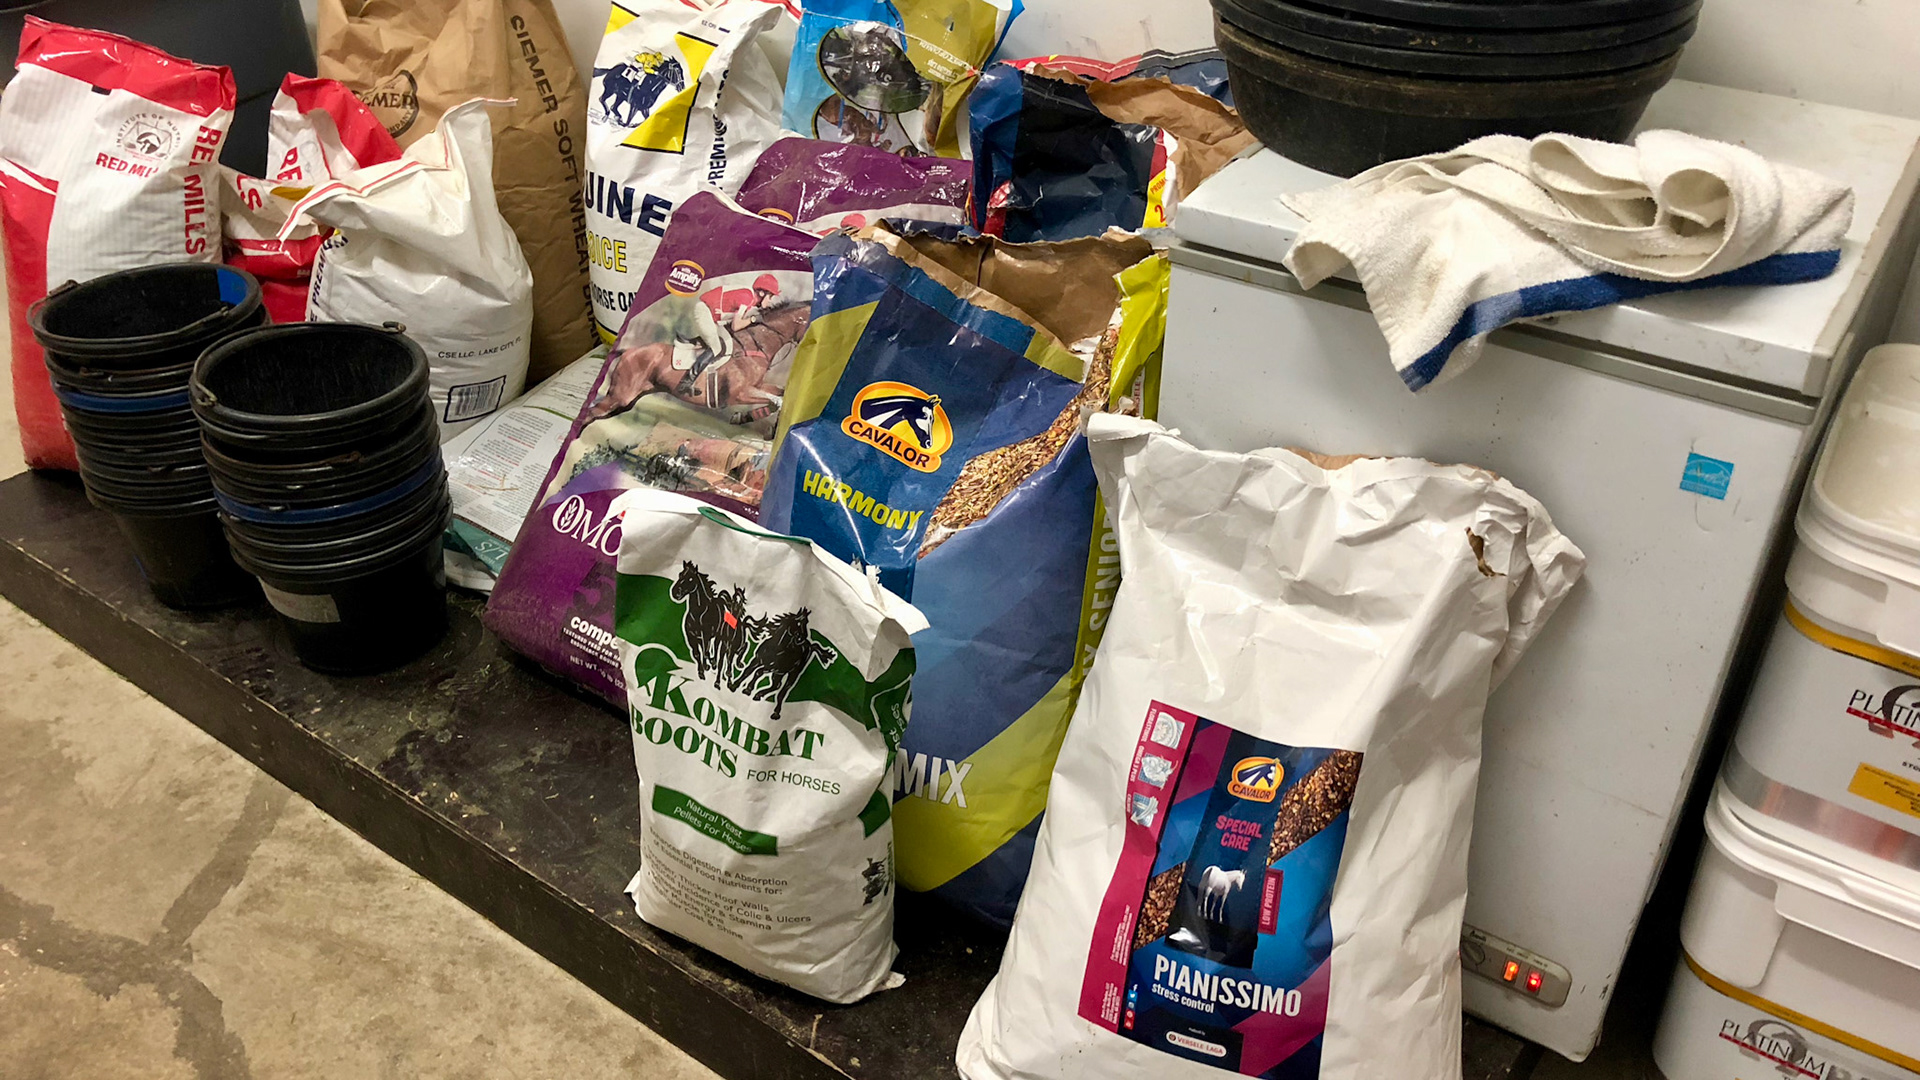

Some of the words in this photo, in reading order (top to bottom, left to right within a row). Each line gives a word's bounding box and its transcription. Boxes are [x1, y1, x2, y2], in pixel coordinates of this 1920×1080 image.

[117, 113, 147, 147] INSTITUTE
[95, 152, 128, 172] RED
[554, 119, 579, 183] SOFT
[184, 174, 206, 255] MILLS
[585, 169, 673, 238] UINE
[670, 267, 702, 287] Amplify
[438, 350, 457, 359] CSE
[478, 346, 499, 356] LAKE
[500, 339, 515, 352] CITY
[849, 421, 931, 468] CAVALOR
[802, 469, 925, 531] HARMONY
[570, 655, 584, 667] NET
[646, 671, 825, 761] KOMBAT
[631, 703, 739, 779] BOOTS
[747, 769, 777, 783] FOR
[781, 770, 842, 796] HORSES
[893, 748, 974, 809] MIX
[1232, 783, 1272, 800] CAVALOR
[673, 806, 702, 828] Pellets
[703, 822, 721, 836] For
[721, 831, 752, 853] Horses
[686, 799, 719, 823] Natural
[720, 818, 743, 838] Yeast
[1215, 815, 1263, 839] SPECIAL
[1220, 833, 1252, 852] CARE
[660, 845, 693, 871] Essential
[695, 866, 716, 881] Food
[717, 876, 762, 894] Nutrients
[764, 886, 783, 896] for:
[683, 851, 722, 875] Digestion
[724, 870, 731, 878] &
[734, 872, 788, 887] Absorption
[677, 881, 721, 908] Incidence
[723, 904, 734, 913] of
[736, 907, 762, 920] Colic
[765, 914, 773, 922] &
[776, 915, 812, 924] Ulcers
[679, 873, 712, 896] Thicker
[713, 891, 739, 906] Hoof
[740, 899, 770, 913] Walls
[1263, 876, 1277, 908] PROTEIN
[684, 894, 716, 915] Energy
[728, 913, 773, 931] Stamina
[703, 910, 725, 925] Tone
[1261, 909, 1273, 926] LOW
[716, 924, 744, 941] Shine
[1151, 983, 1180, 1003] stress
[1180, 994, 1215, 1014] control
[1153, 953, 1303, 1018] PIANISSIMO
[1177, 1037, 1204, 1050] VERSELE
